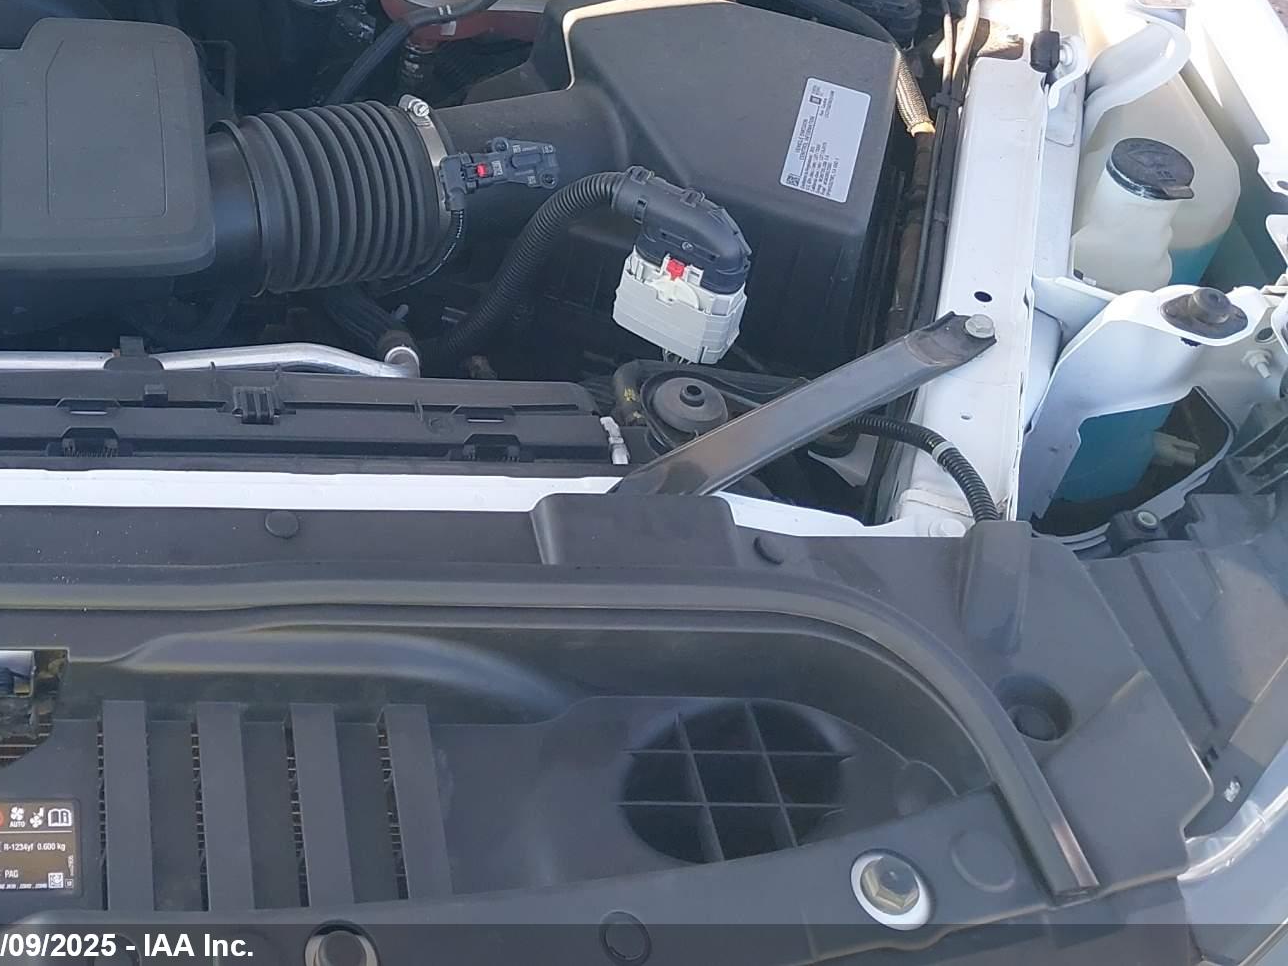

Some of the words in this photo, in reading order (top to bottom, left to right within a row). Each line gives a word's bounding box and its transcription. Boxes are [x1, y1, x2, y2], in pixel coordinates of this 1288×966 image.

[3, 842, 34, 852] R-1234yf
[57, 842, 66, 852] kg
[4, 869, 19, 878] PAG
